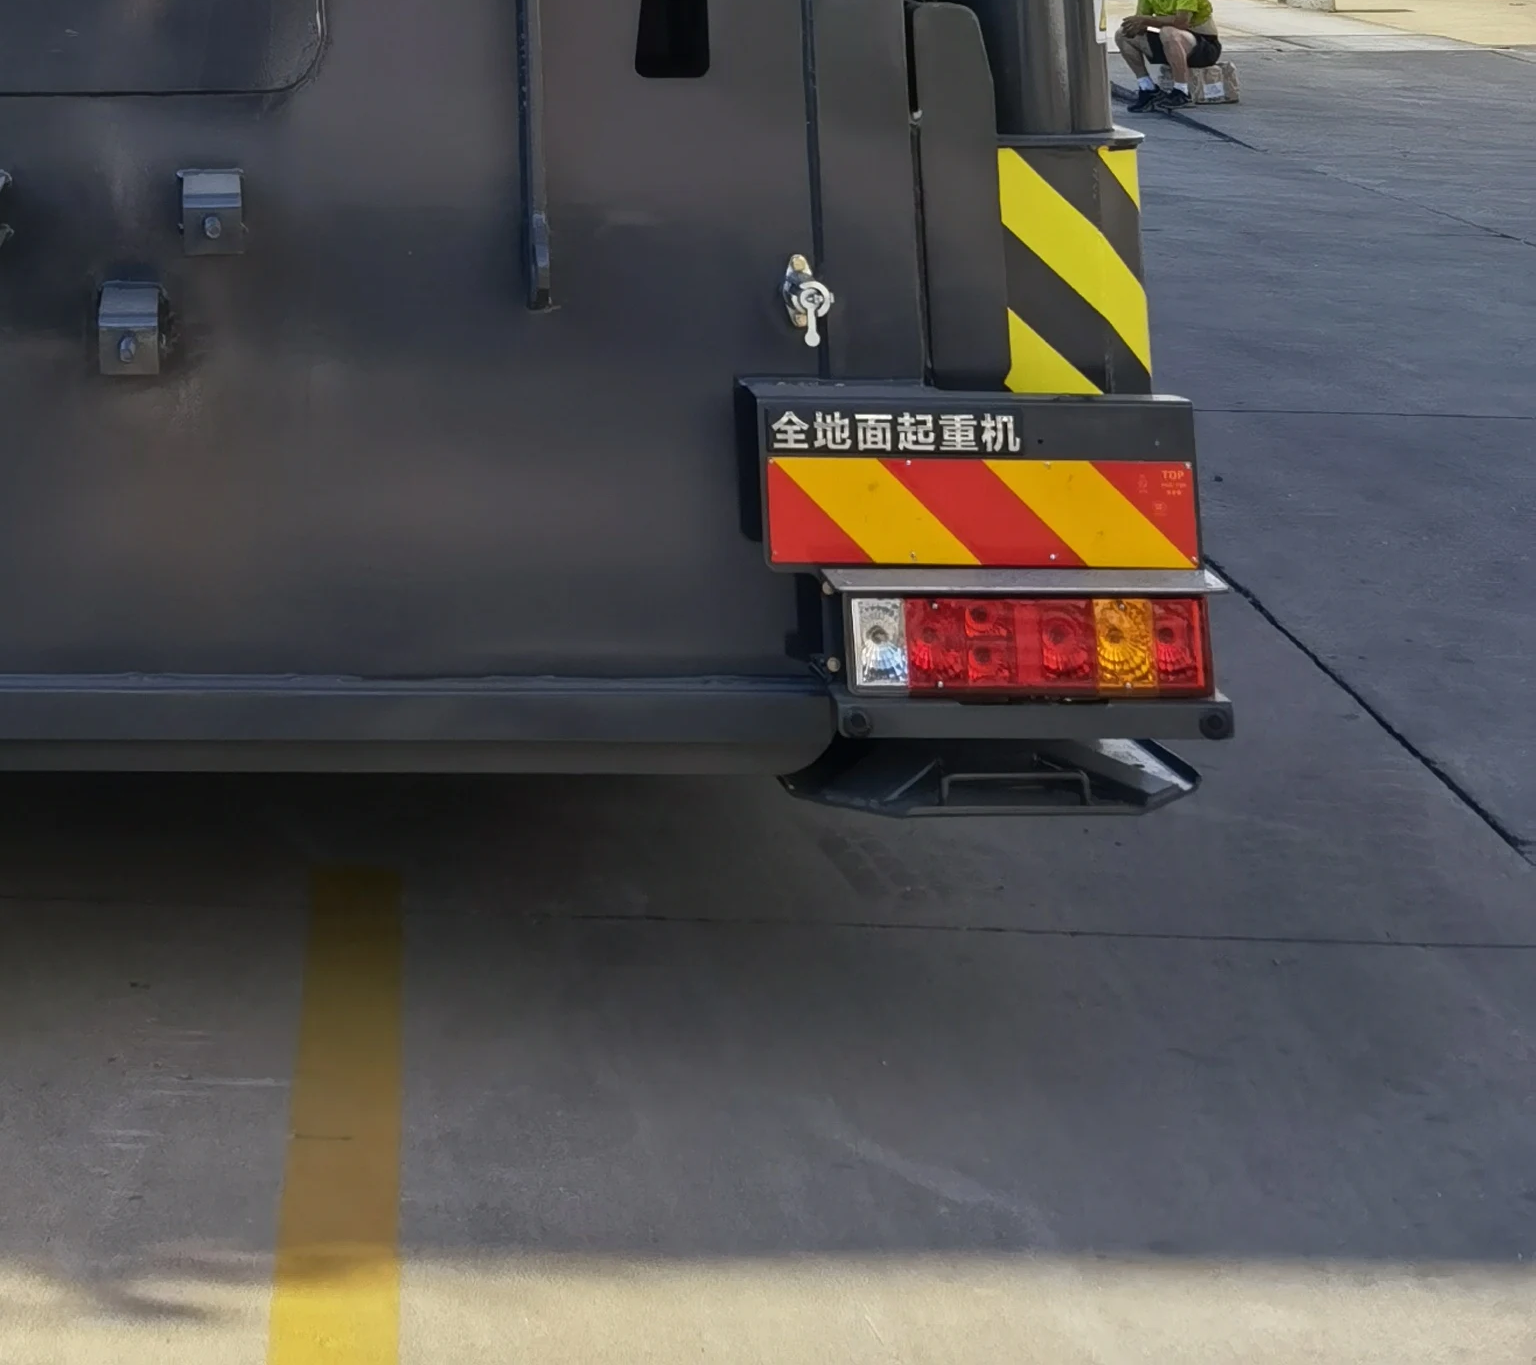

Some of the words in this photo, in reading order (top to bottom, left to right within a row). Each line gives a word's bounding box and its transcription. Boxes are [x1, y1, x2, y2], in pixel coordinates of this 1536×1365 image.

[771, 410, 1021, 452] 全地面起重机
[1161, 470, 1185, 480] TOP
